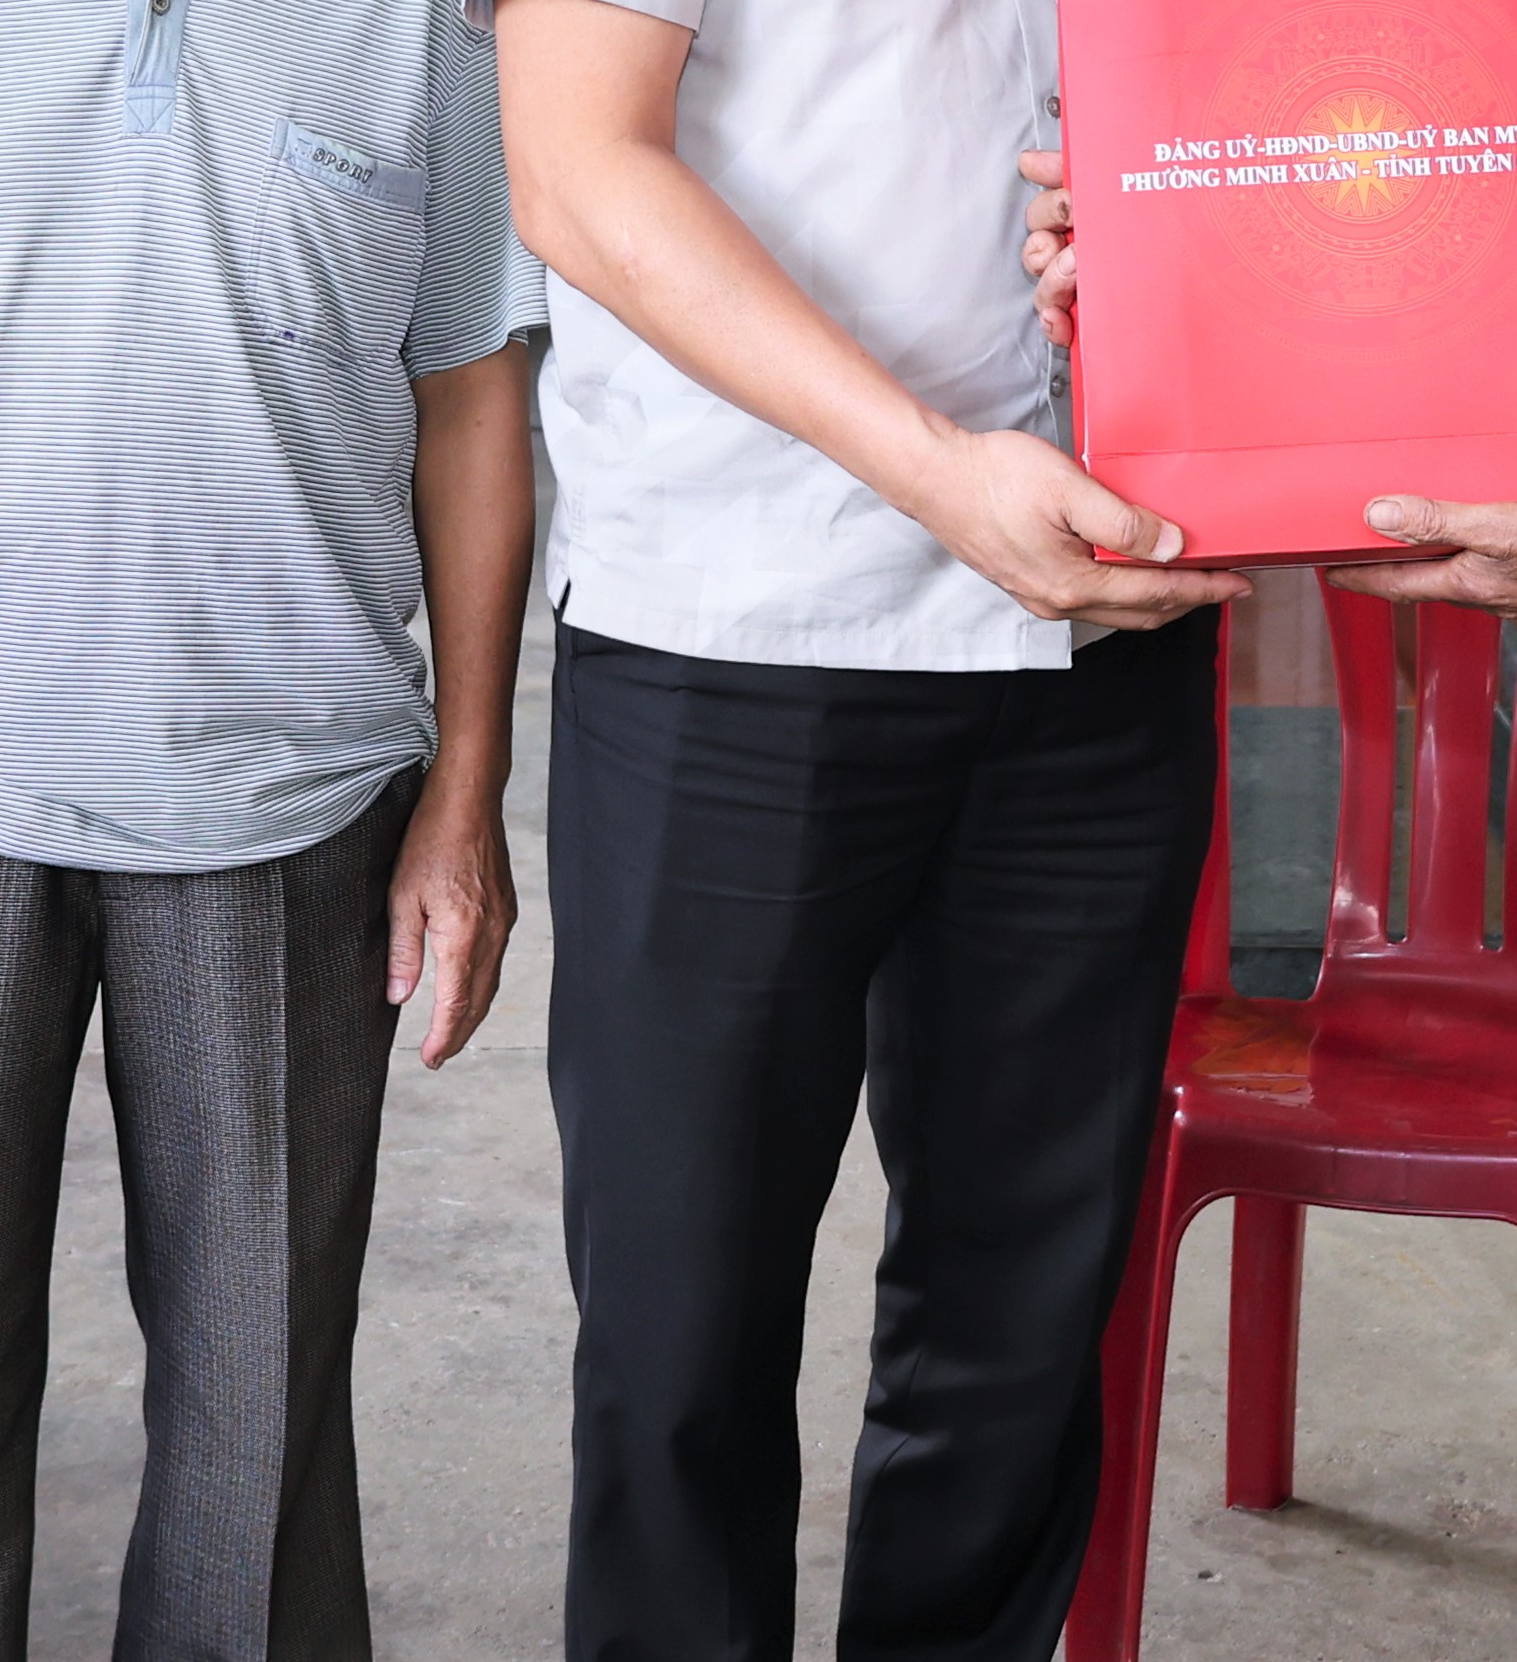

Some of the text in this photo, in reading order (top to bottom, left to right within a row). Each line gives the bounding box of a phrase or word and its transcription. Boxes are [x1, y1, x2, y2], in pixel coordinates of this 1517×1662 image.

[1154, 137, 1221, 162] ĐẢNG
[1225, 124, 1438, 158] UỶ-HĐND-UBND-UỶ
[1443, 126, 1492, 147] BAN
[312, 147, 374, 184] SPORT
[1120, 165, 1221, 192] PHƯỜNG
[1225, 165, 1289, 186] MINH
[1293, 156, 1356, 182] XUÂN
[1374, 154, 1432, 178] TỈNH
[1435, 148, 1513, 176] TUYÊN
